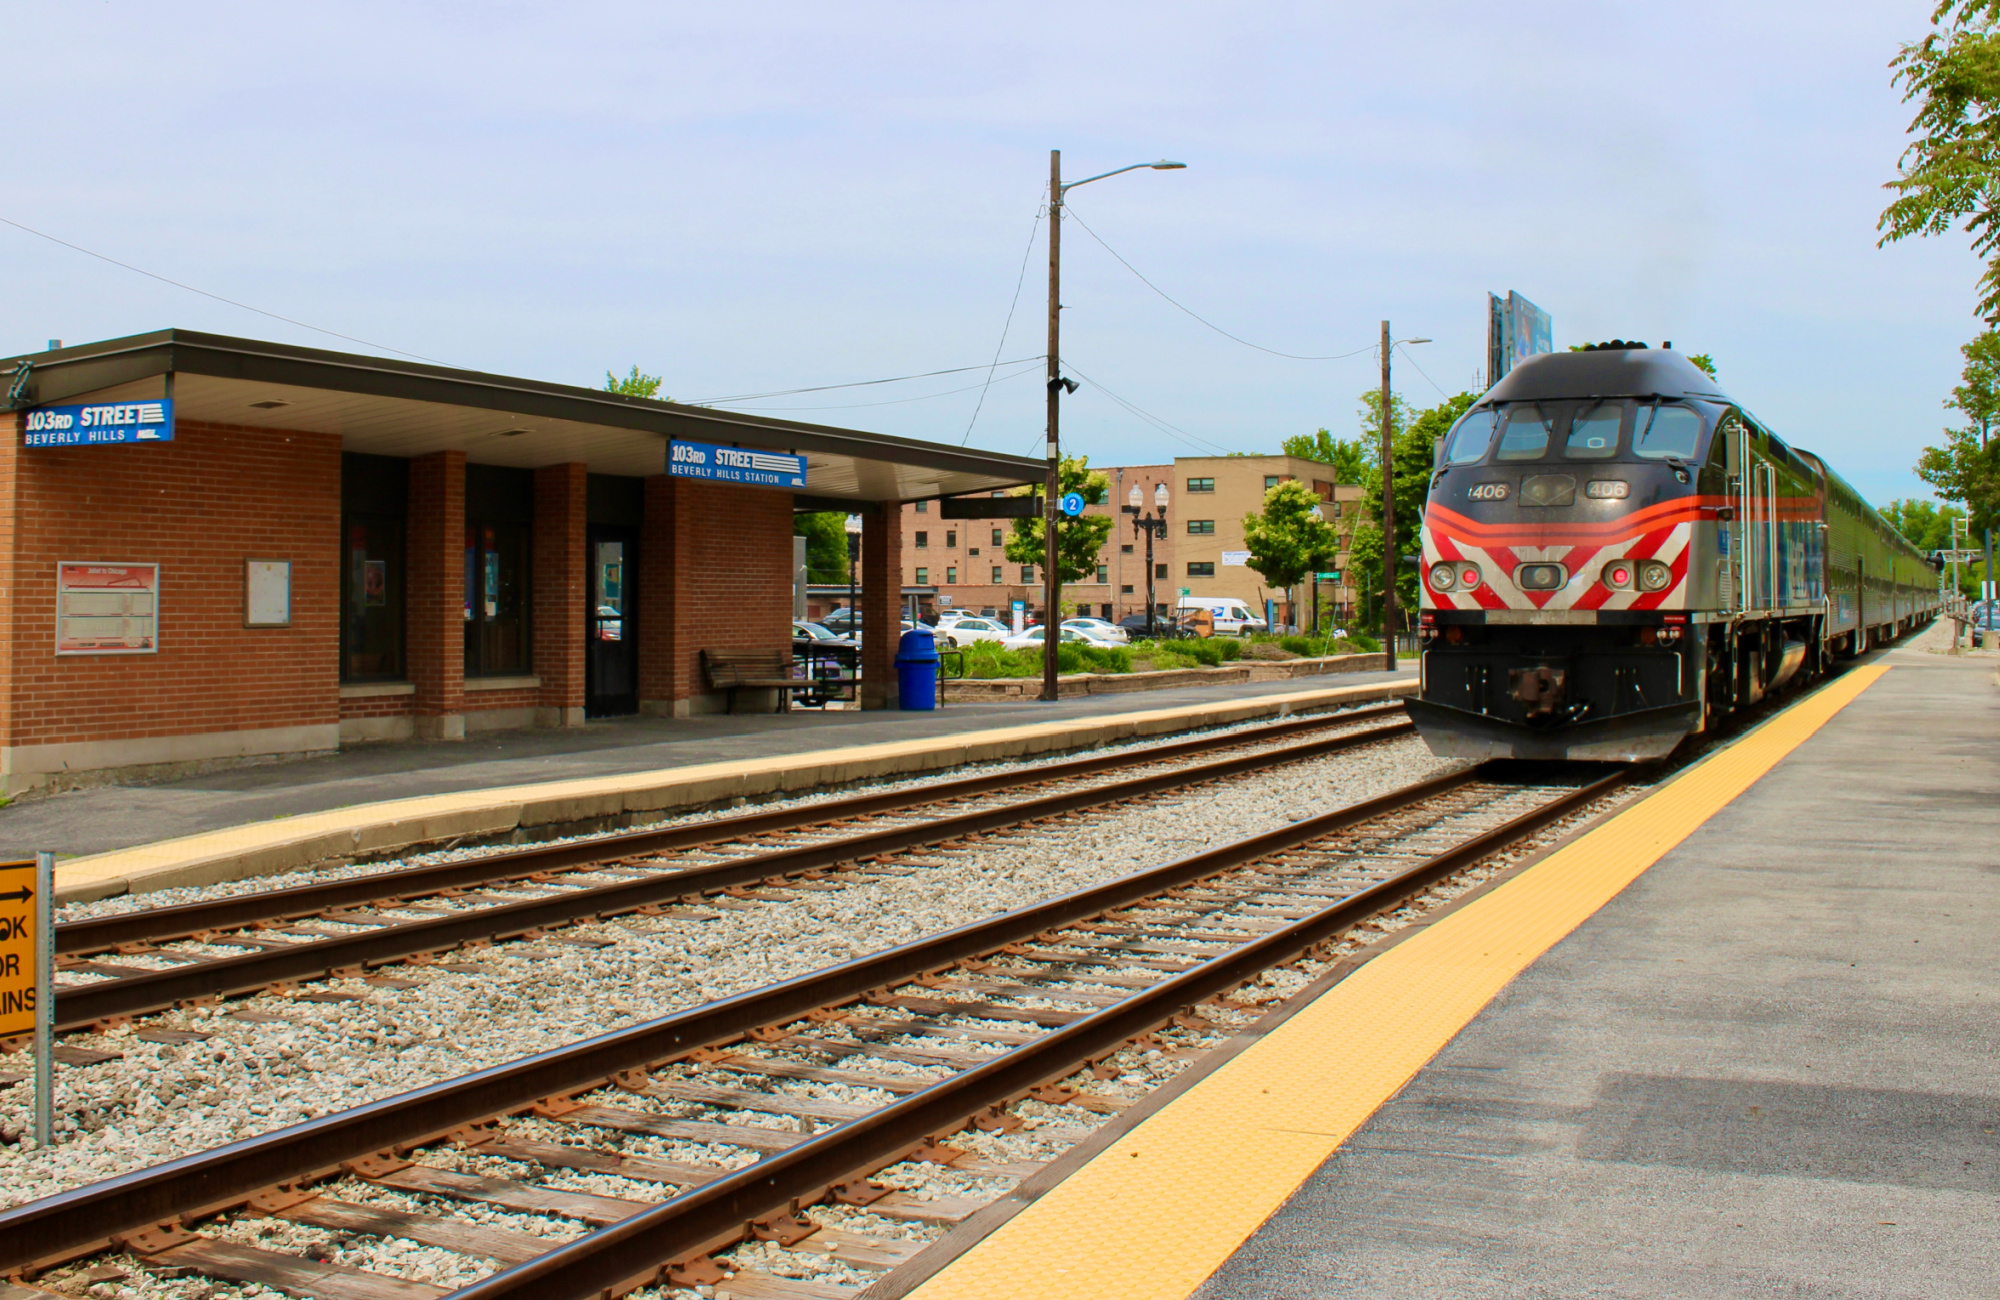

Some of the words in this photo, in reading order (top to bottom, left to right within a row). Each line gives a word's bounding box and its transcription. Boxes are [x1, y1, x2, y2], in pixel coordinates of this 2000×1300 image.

[26, 411, 73, 431] 103RD
[80, 403, 147, 427] STREET
[25, 432, 81, 445] BEVERLY
[89, 429, 125, 442] HILLS
[672, 445, 705, 464] 103RD
[715, 449, 757, 469] STREET
[671, 464, 711, 477] BEVERLY
[716, 469, 740, 480] HILLS
[745, 472, 779, 484] STATION
[1472, 484, 1506, 499] 406
[1589, 482, 1625, 497] 406
[1069, 498, 1077, 511] 2
[0, 986, 36, 1015] INS
